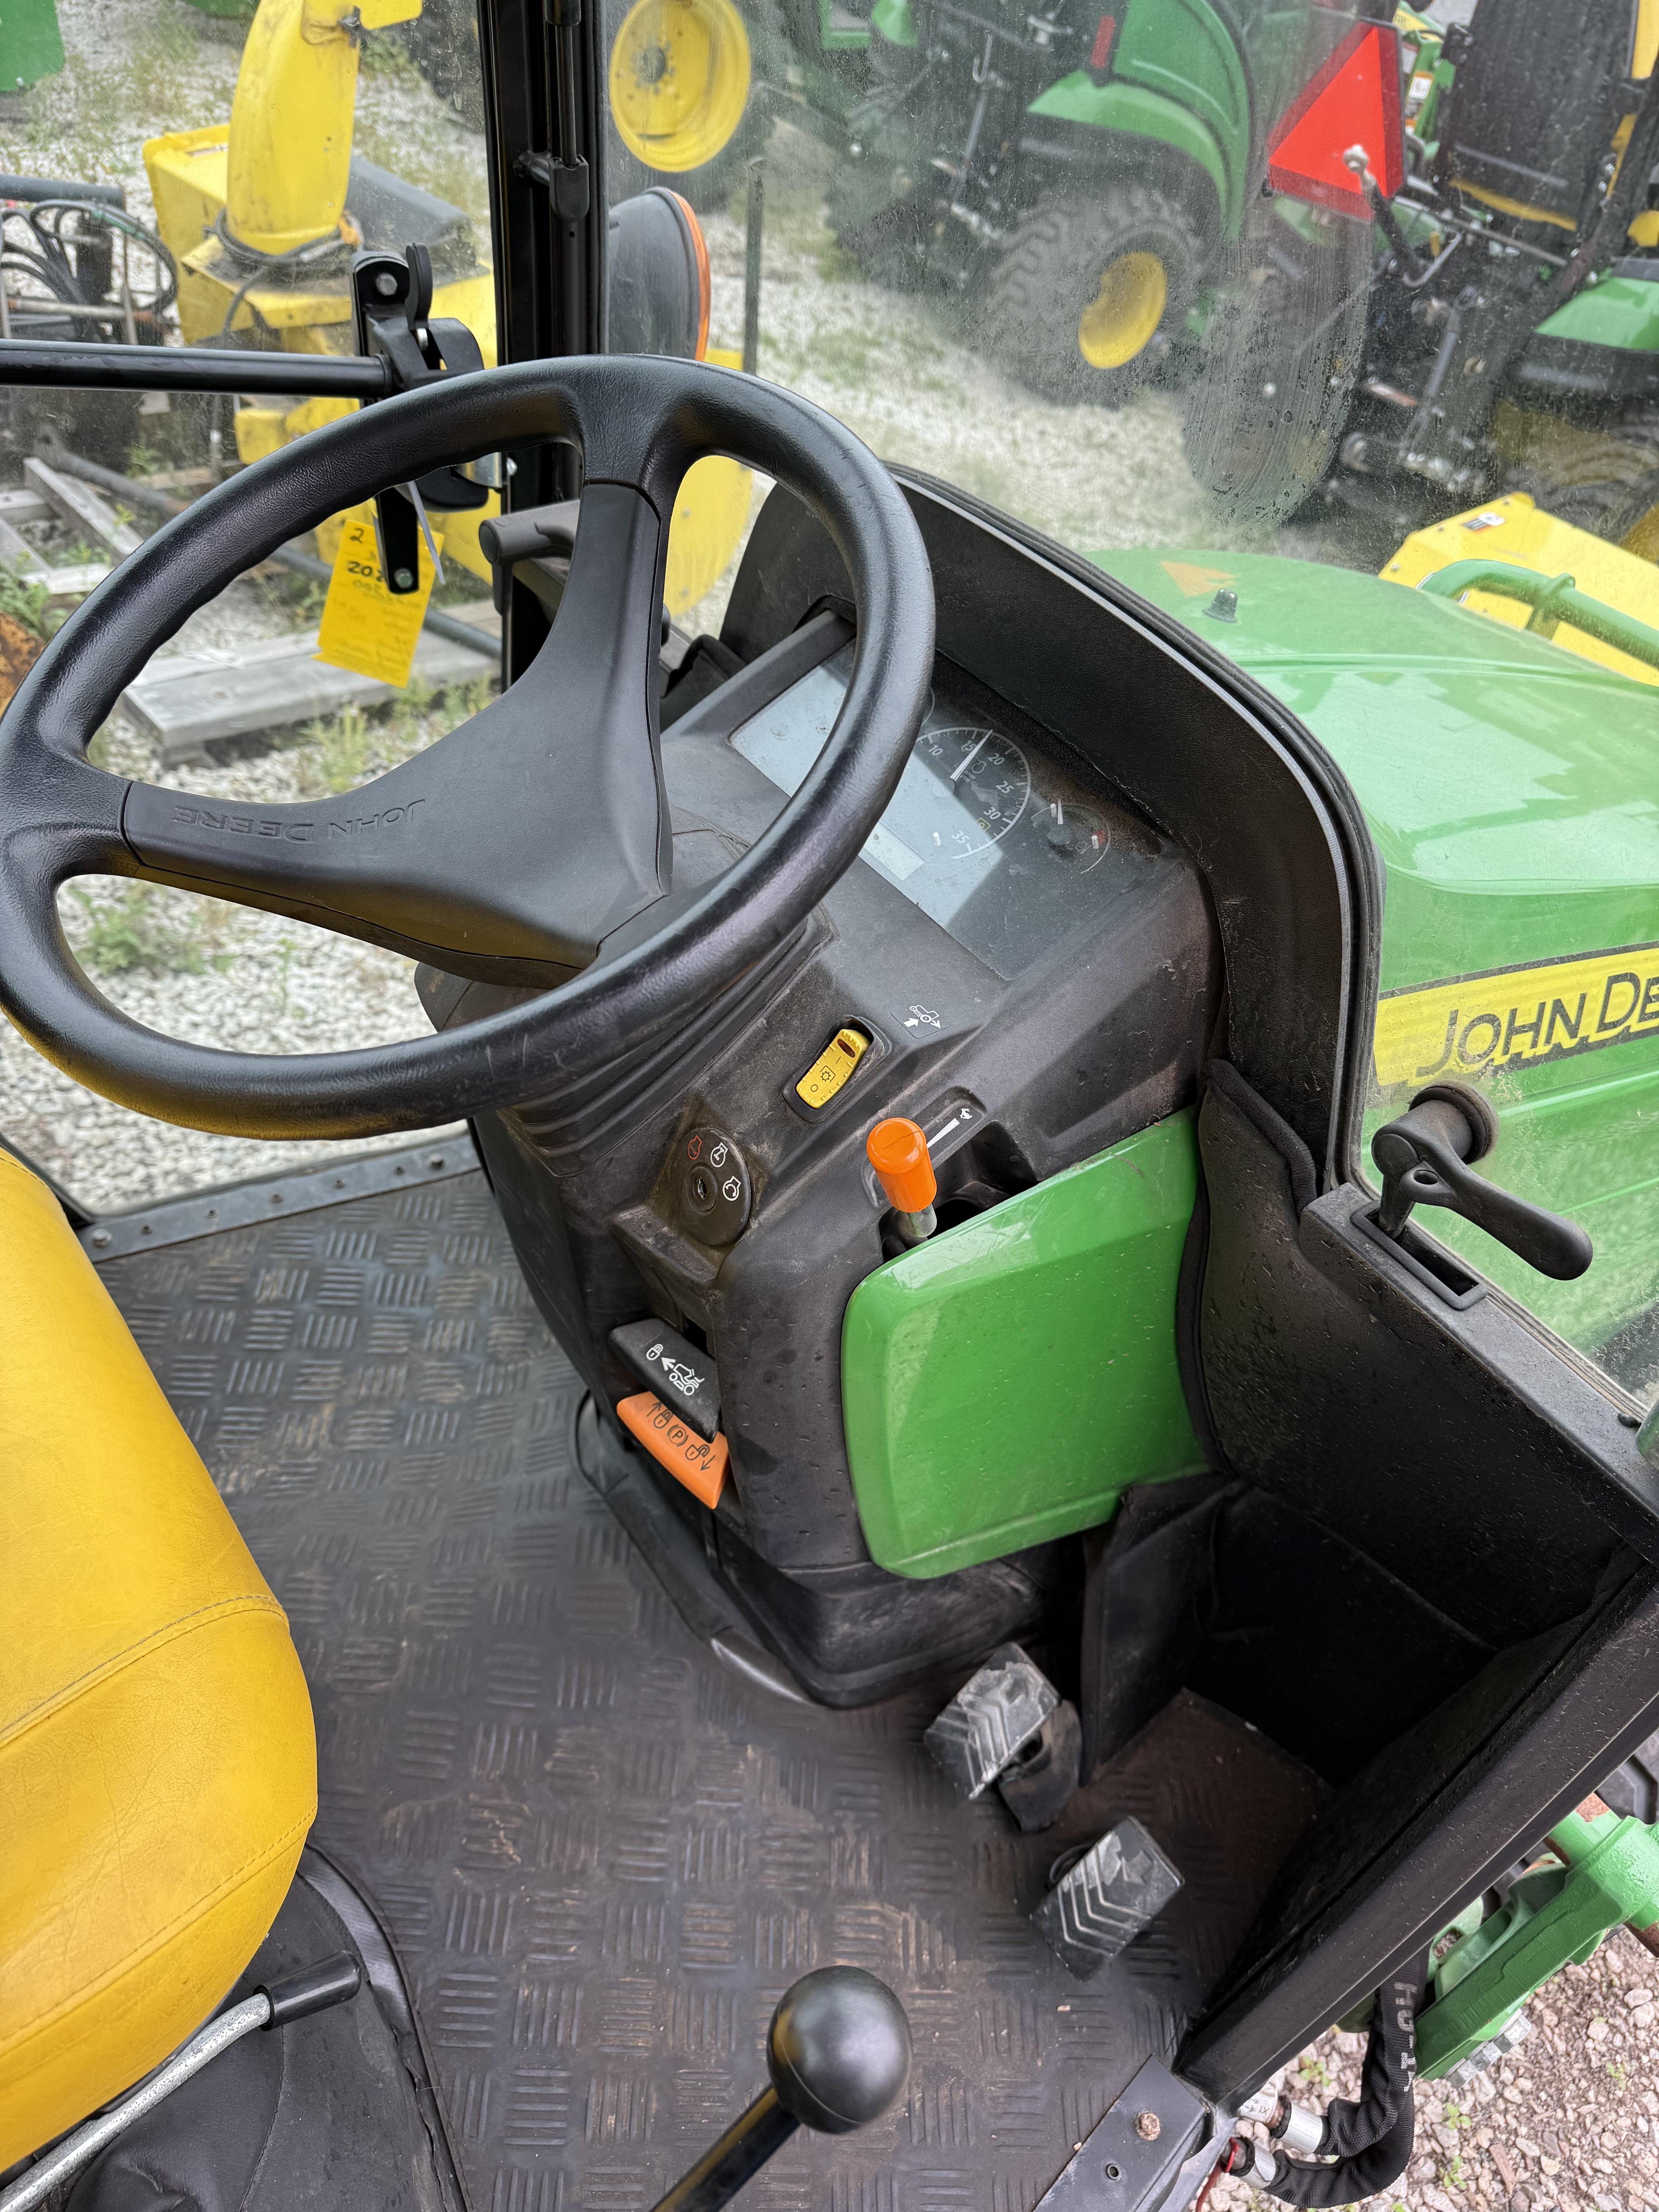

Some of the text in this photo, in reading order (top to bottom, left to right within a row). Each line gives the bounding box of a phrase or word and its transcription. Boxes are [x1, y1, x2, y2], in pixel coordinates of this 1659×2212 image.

[928, 744, 943, 756] 10
[962, 740, 977, 752] 15
[988, 753, 1005, 765] 20
[996, 781, 1014, 793] 25
[983, 807, 1001, 820] 30
[172, 799, 425, 843] JOHN DEERE
[951, 830, 970, 844] 35
[1415, 992, 1587, 1077] JOHN
[672, 1430, 684, 1439] P
